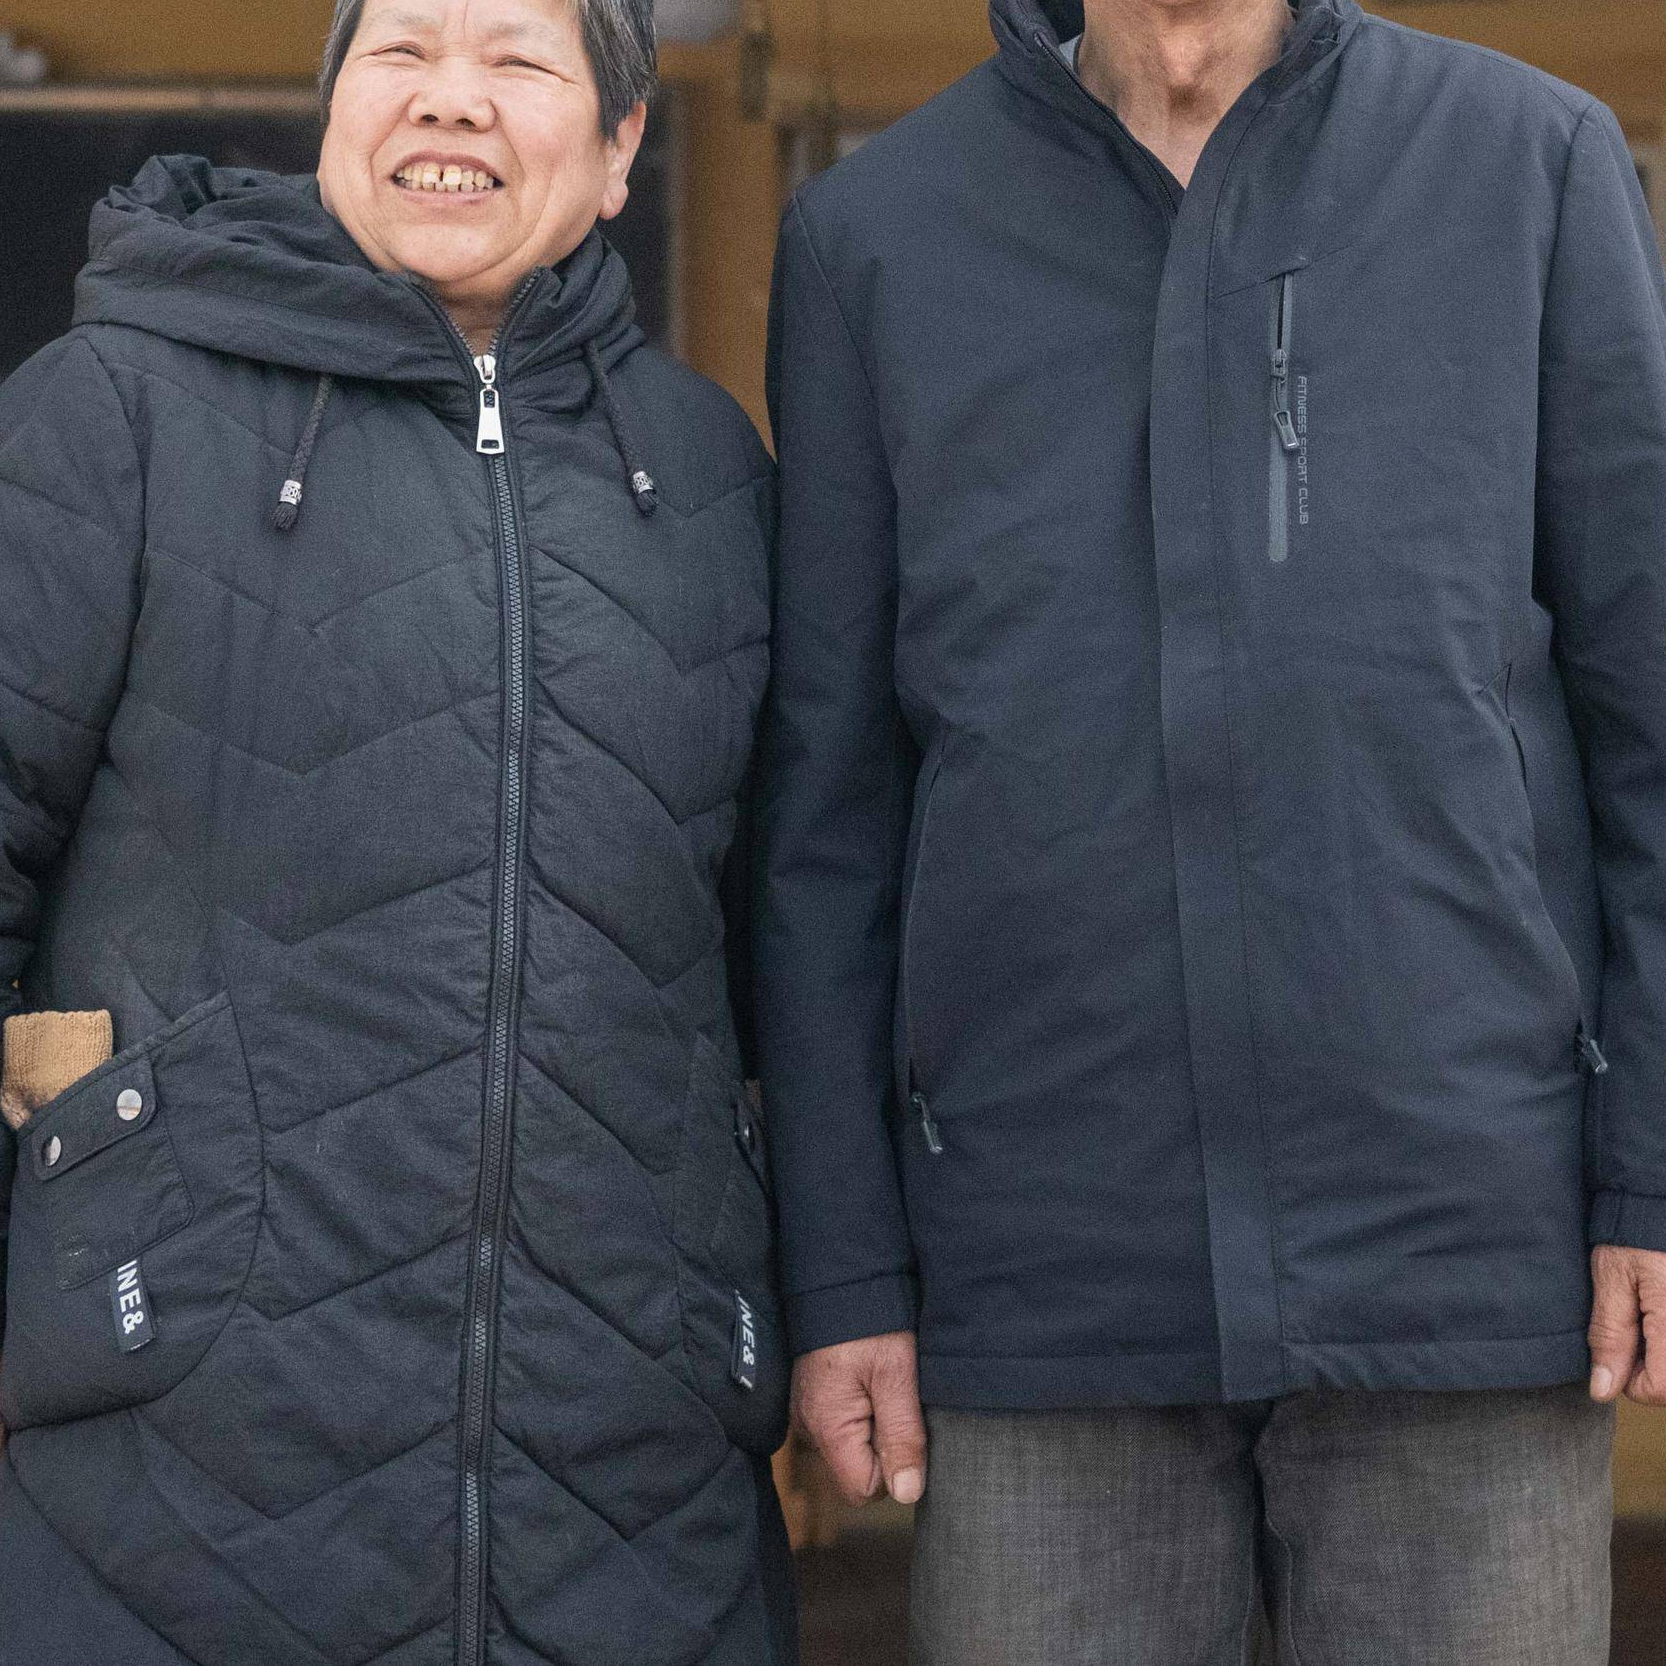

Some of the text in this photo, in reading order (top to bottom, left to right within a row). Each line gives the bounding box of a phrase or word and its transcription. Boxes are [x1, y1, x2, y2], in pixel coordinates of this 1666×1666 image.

[1297, 375, 1309, 525] FITNESS SPORT CLUB
[117, 1259, 144, 1335] INE&
[735, 1288, 755, 1366] INE&
